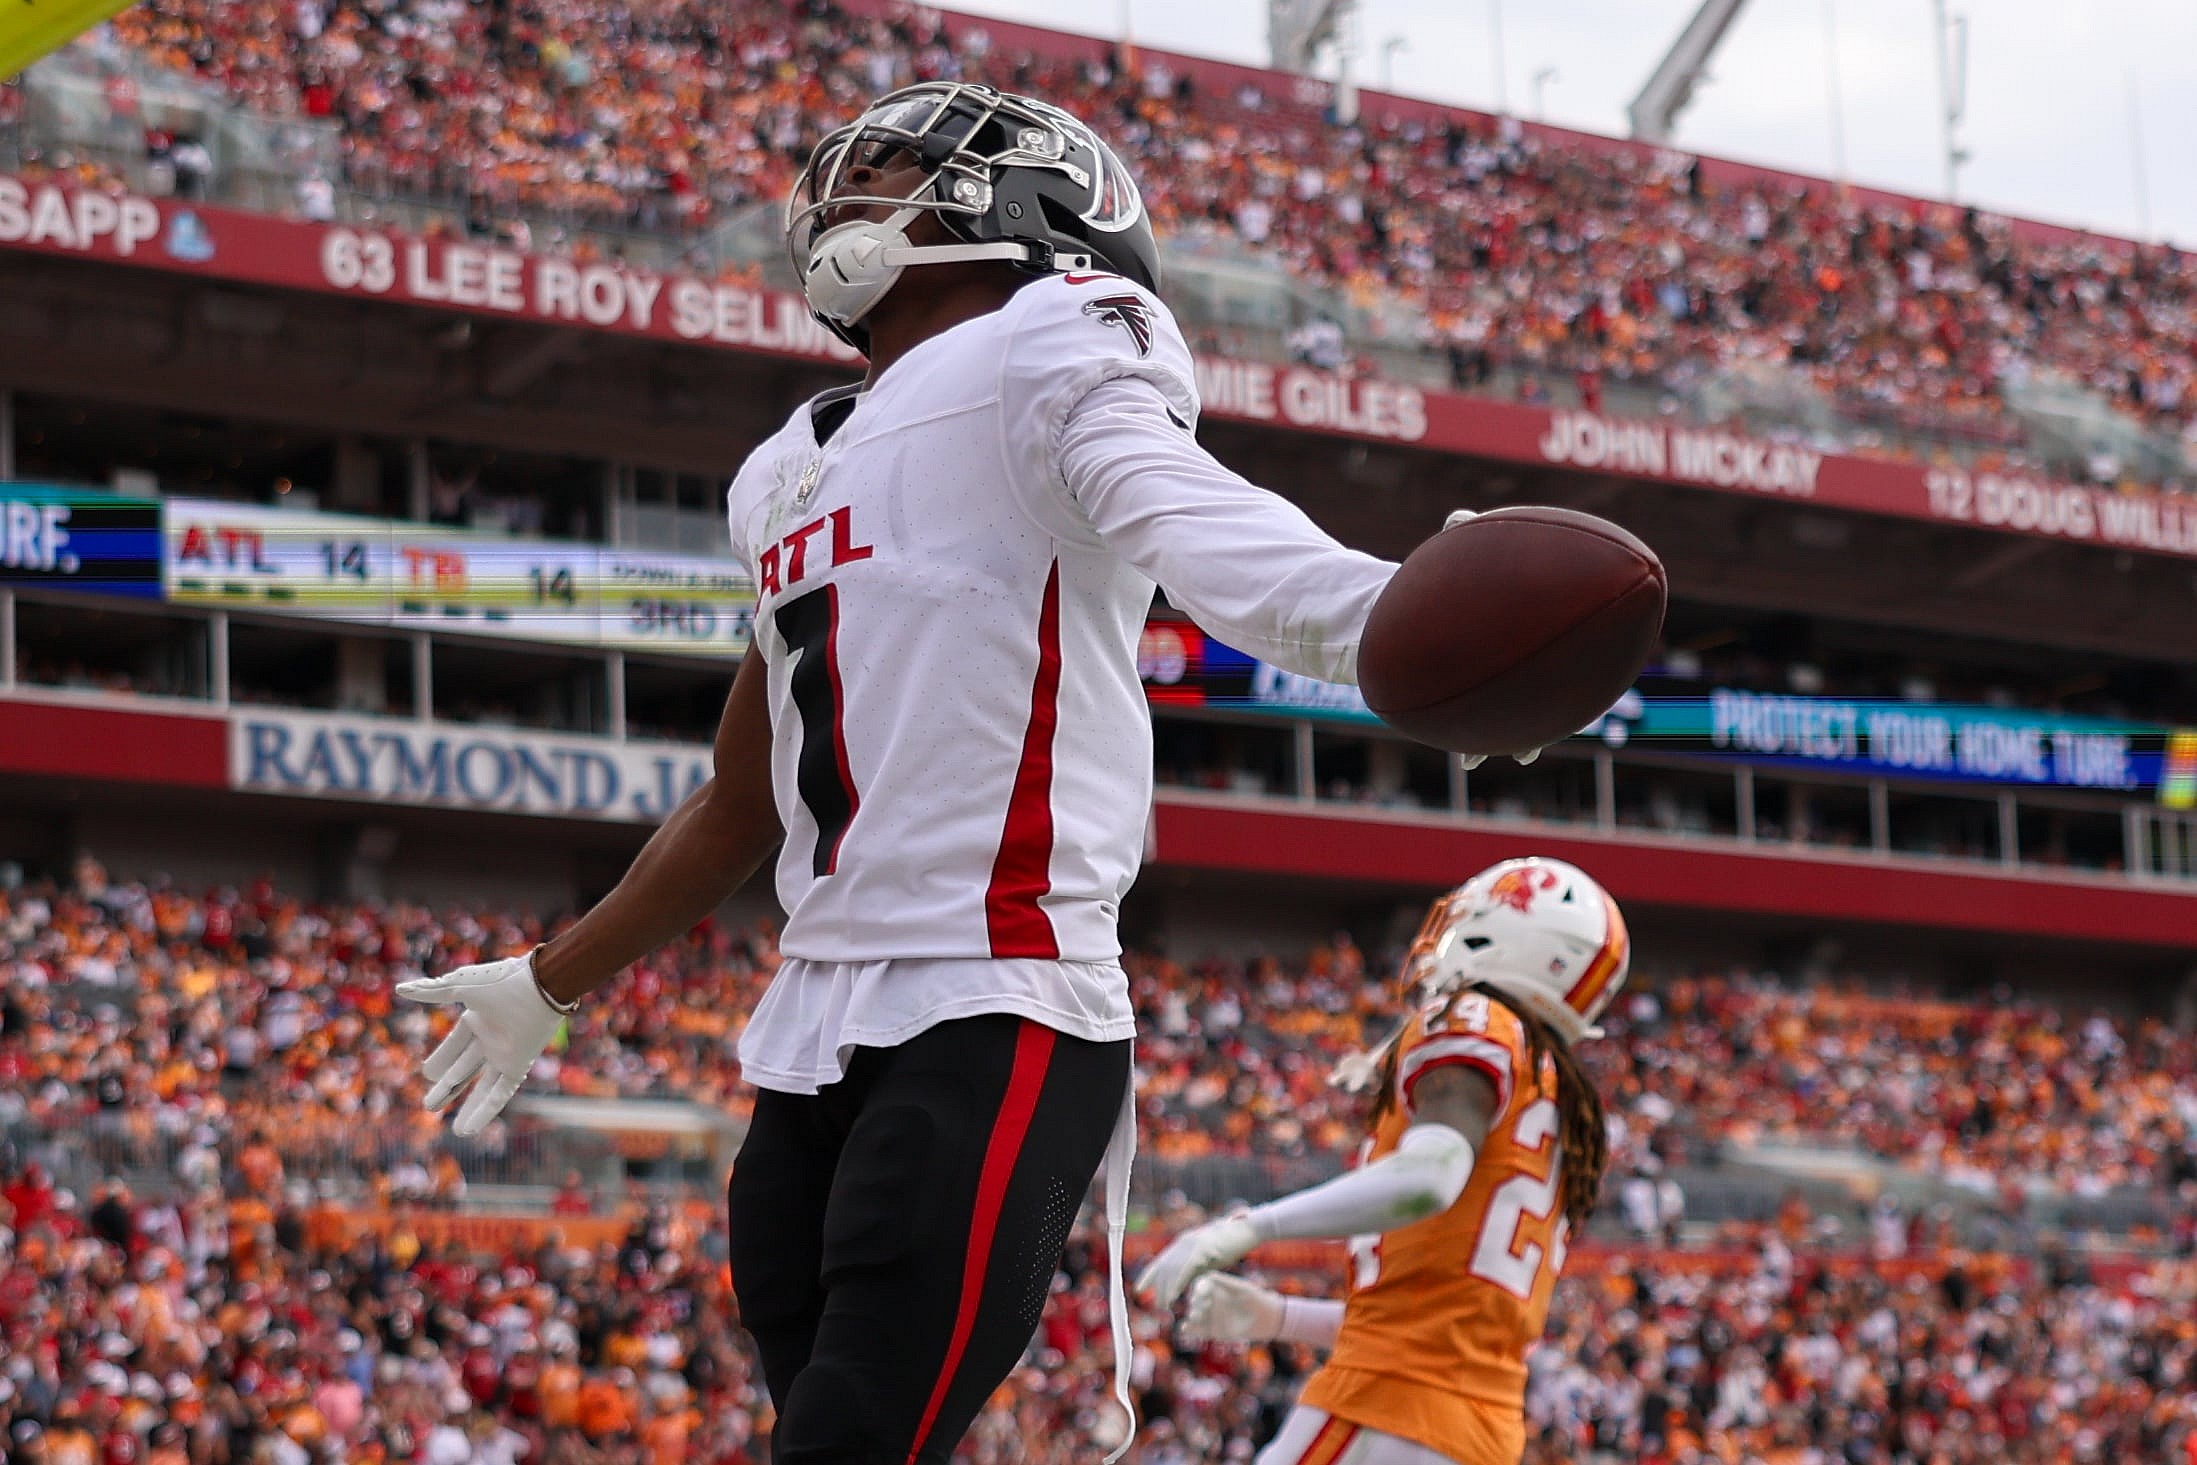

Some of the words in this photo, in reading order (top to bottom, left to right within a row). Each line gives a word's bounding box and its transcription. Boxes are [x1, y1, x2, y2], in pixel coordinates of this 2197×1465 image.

[0, 178, 160, 256] SAPP
[322, 228, 395, 292] 63
[407, 241, 524, 311] LEE
[535, 262, 662, 330] ROY
[669, 283, 858, 360] SELM
[1199, 361, 1276, 419] MIE
[1280, 371, 1427, 441] GILES
[1539, 412, 1665, 476] JOHN
[0, 501, 80, 574] RF.
[1925, 470, 1972, 519] 12
[1976, 474, 2096, 538] DOUG
[181, 525, 284, 574] ATL
[323, 541, 368, 583] 14
[403, 544, 467, 593] TB
[530, 565, 576, 606] 14
[755, 505, 873, 619] ATL
[631, 597, 716, 638] 3RD
[246, 721, 623, 811] RAYMOND
[774, 583, 860, 880] 1
[1711, 688, 1857, 761] PROTECT
[1868, 710, 1952, 771] YOUR
[1957, 721, 2048, 780] HOME
[1469, 1098, 1570, 1300] 2
